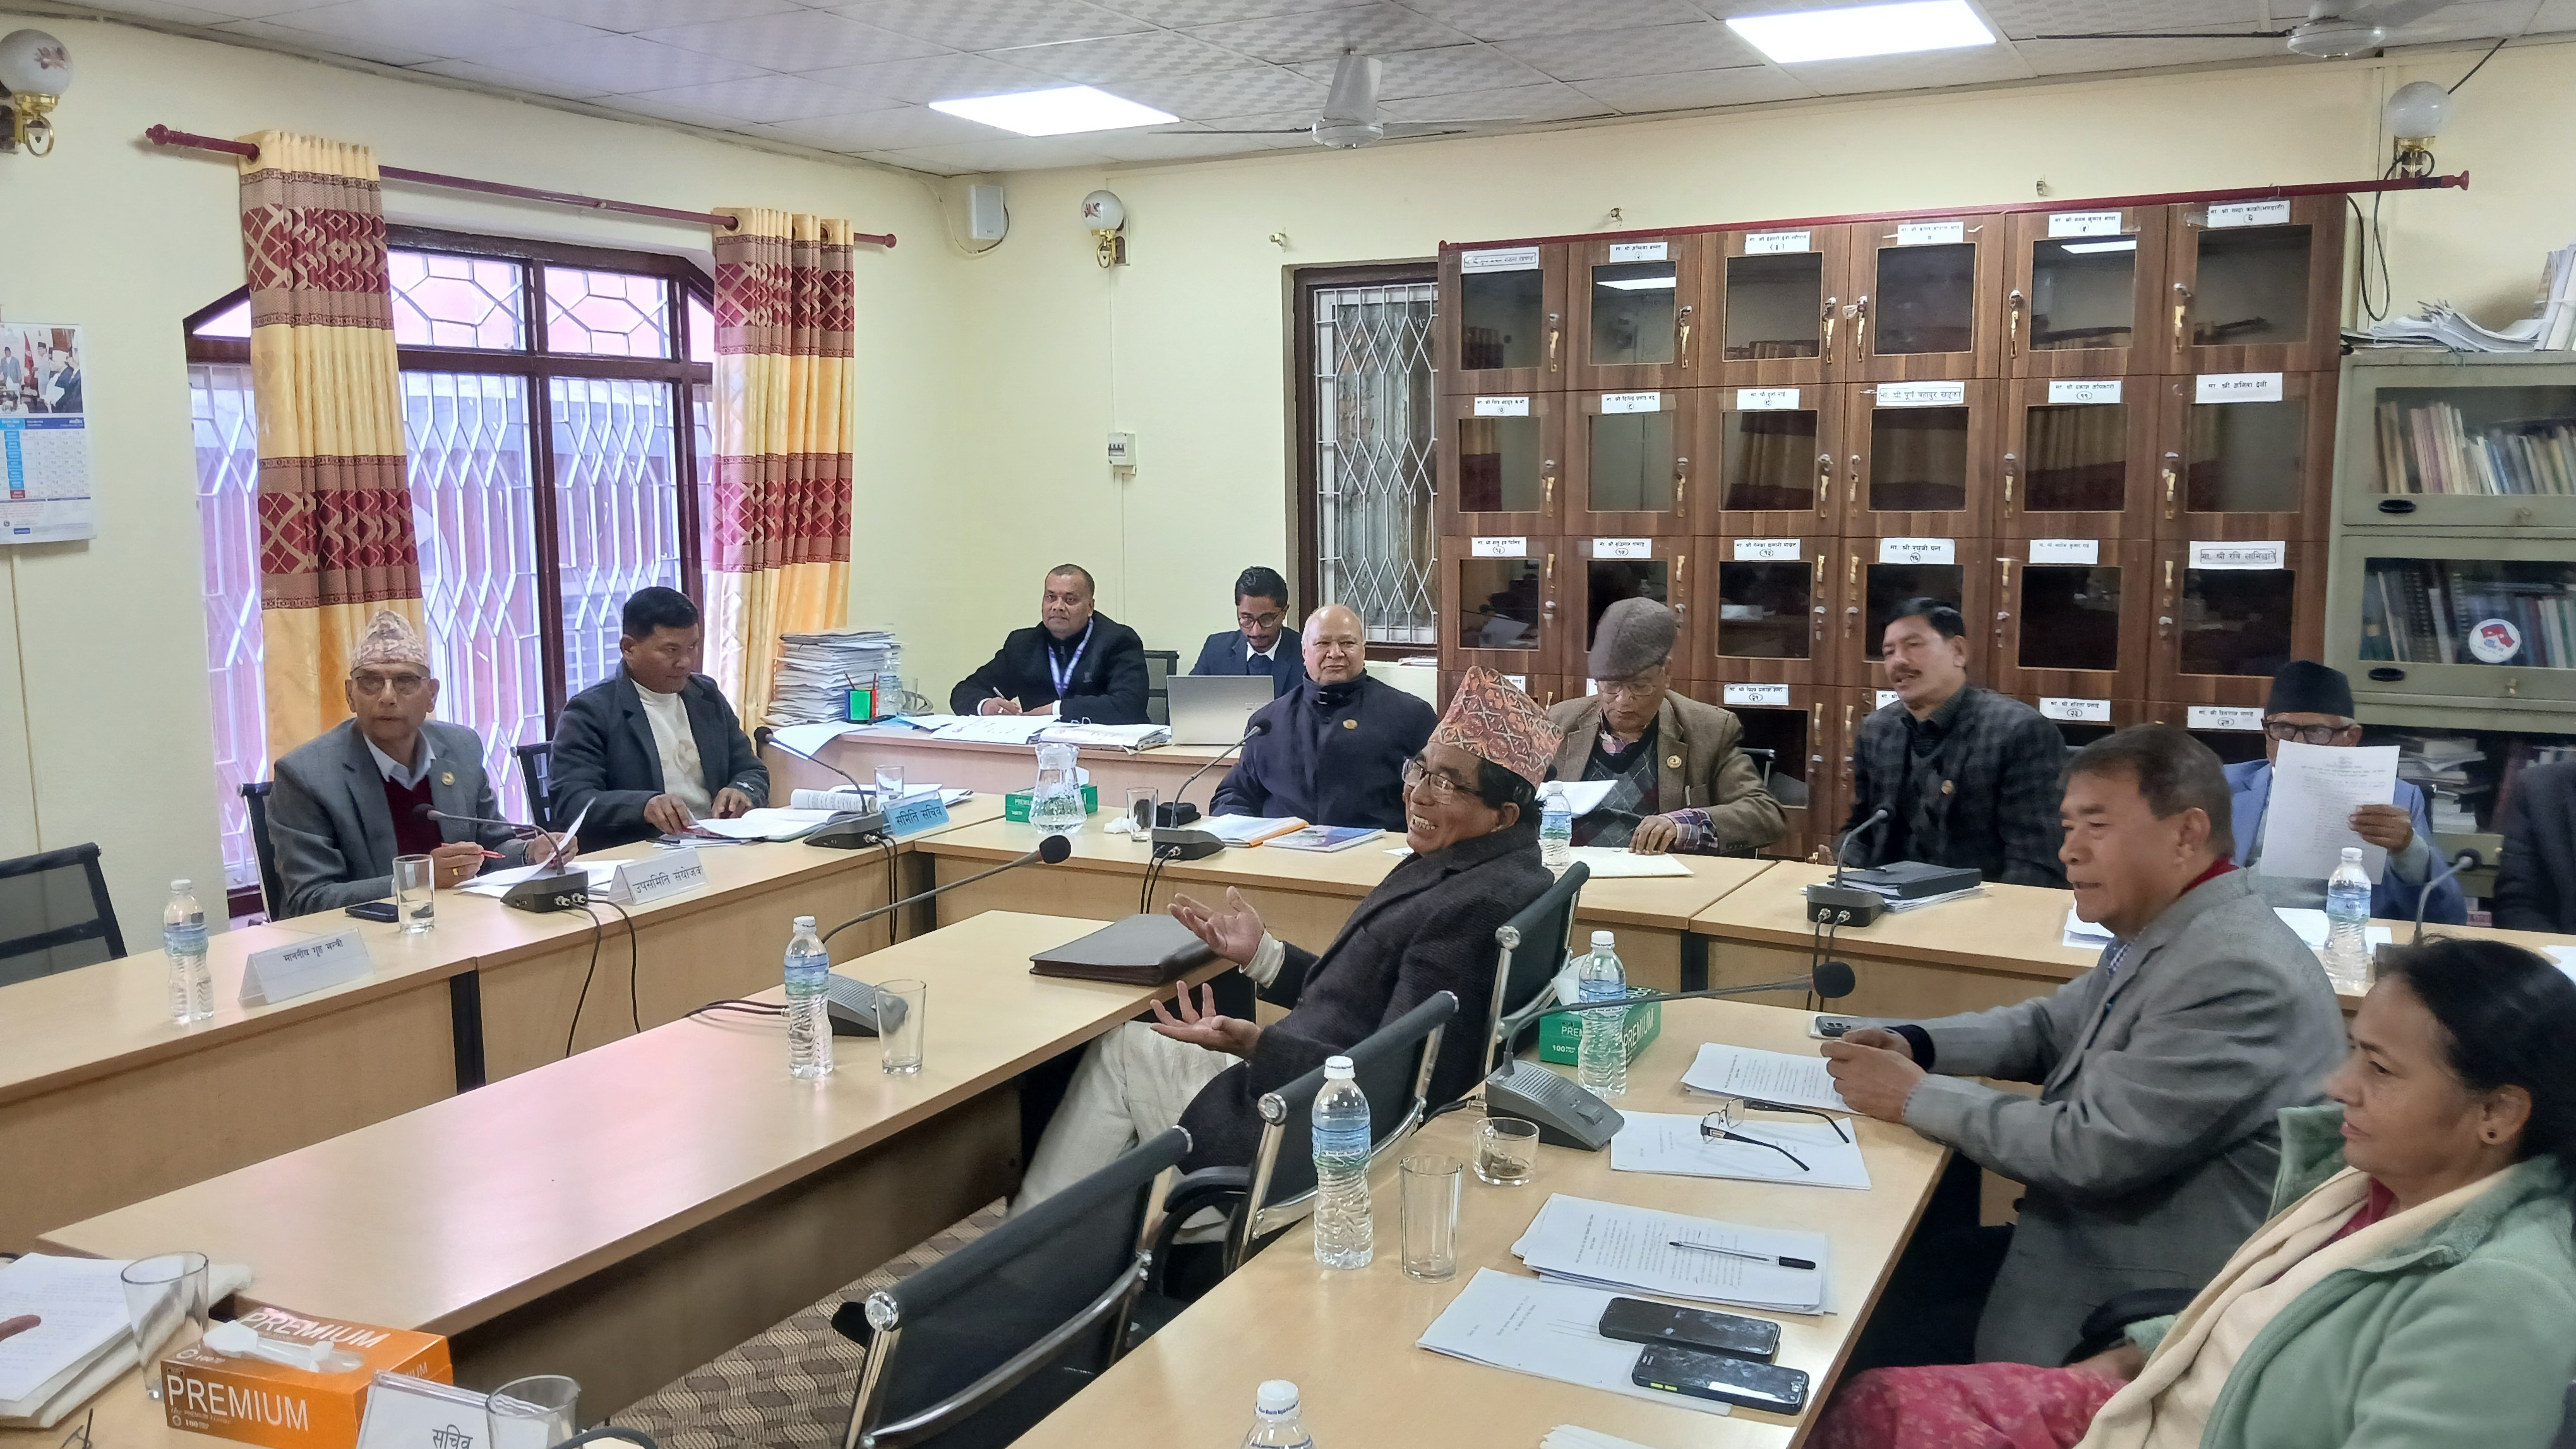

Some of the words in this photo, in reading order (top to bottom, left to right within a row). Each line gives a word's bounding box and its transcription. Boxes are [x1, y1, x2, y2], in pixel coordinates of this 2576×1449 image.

[895, 809, 920, 826] समिति
[920, 804, 943, 820] सचिव
[632, 873, 671, 893] उपसमिति
[283, 948, 309, 961] माननीय
[311, 946, 323, 957] गृह
[325, 938, 343, 950] मन्त्री
[1622, 1008, 1653, 1052] PREMIUM
[238, 1311, 392, 1348] PREMIUM
[167, 1374, 309, 1431] PREMIUM
[432, 1424, 473, 1449] सचिव
